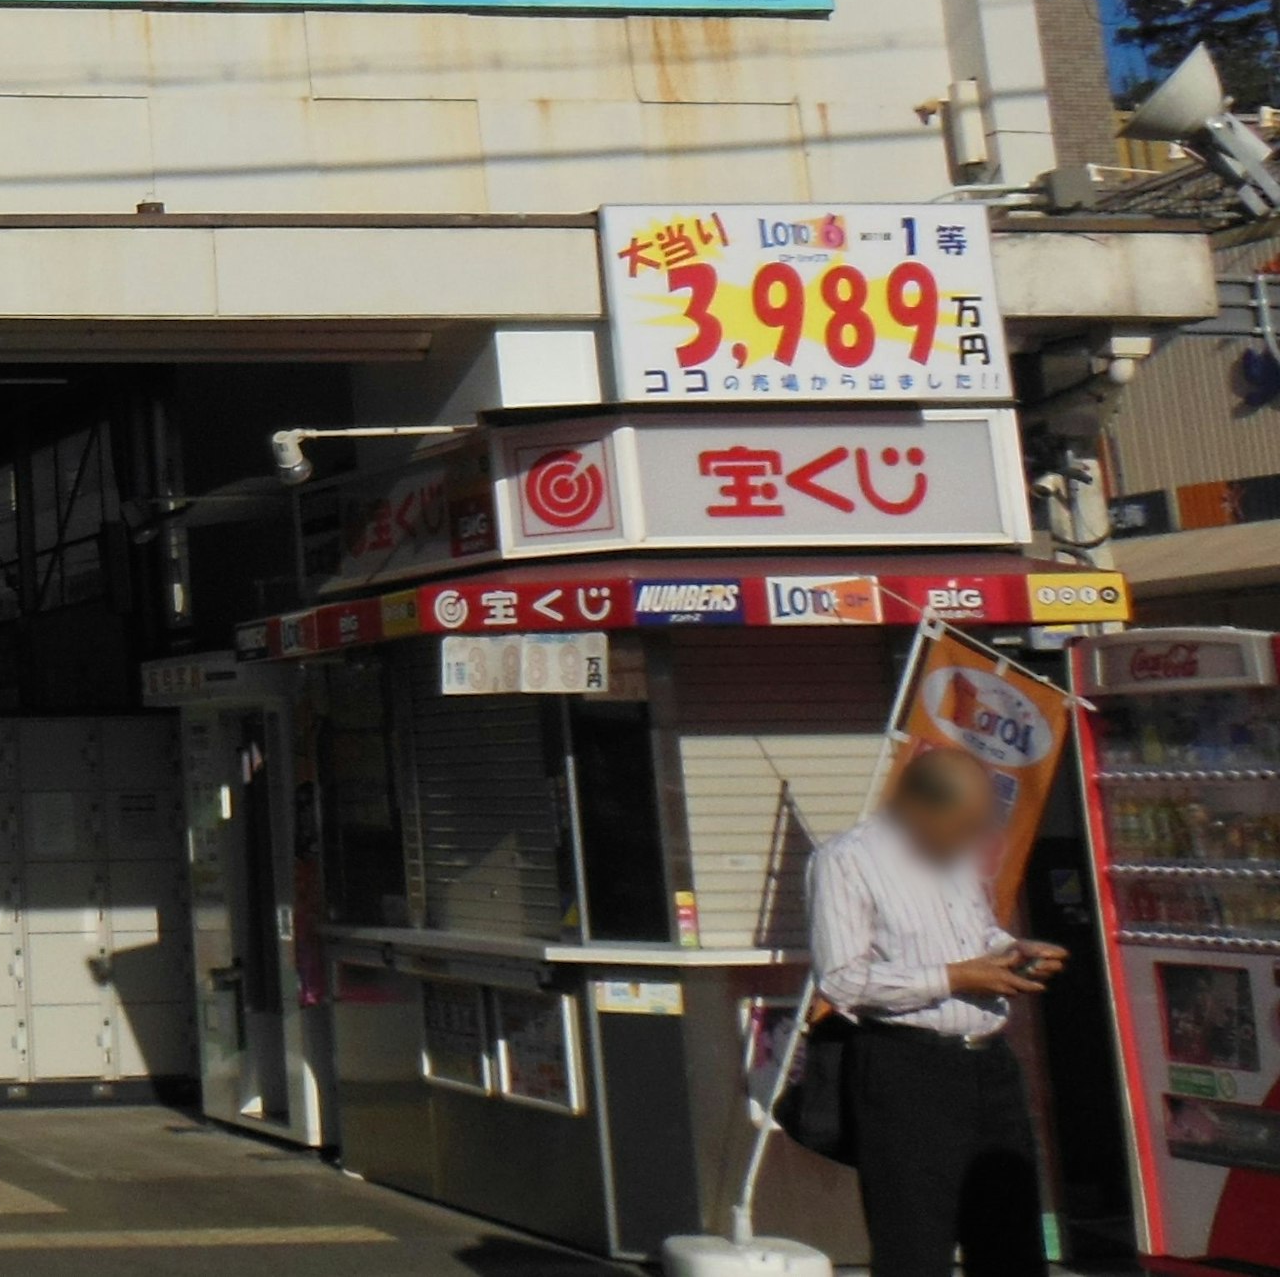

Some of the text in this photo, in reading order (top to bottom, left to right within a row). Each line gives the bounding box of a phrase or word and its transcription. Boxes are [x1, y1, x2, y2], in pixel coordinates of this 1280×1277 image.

[618, 212, 729, 278] 大当り
[667, 261, 940, 369] 3,989
[951, 296, 991, 365] 万円
[698, 445, 929, 518] 宝くじ
[481, 586, 611, 626] 宝くじ
[636, 584, 740, 612] NUMBERS
[927, 580, 983, 609] BIG
